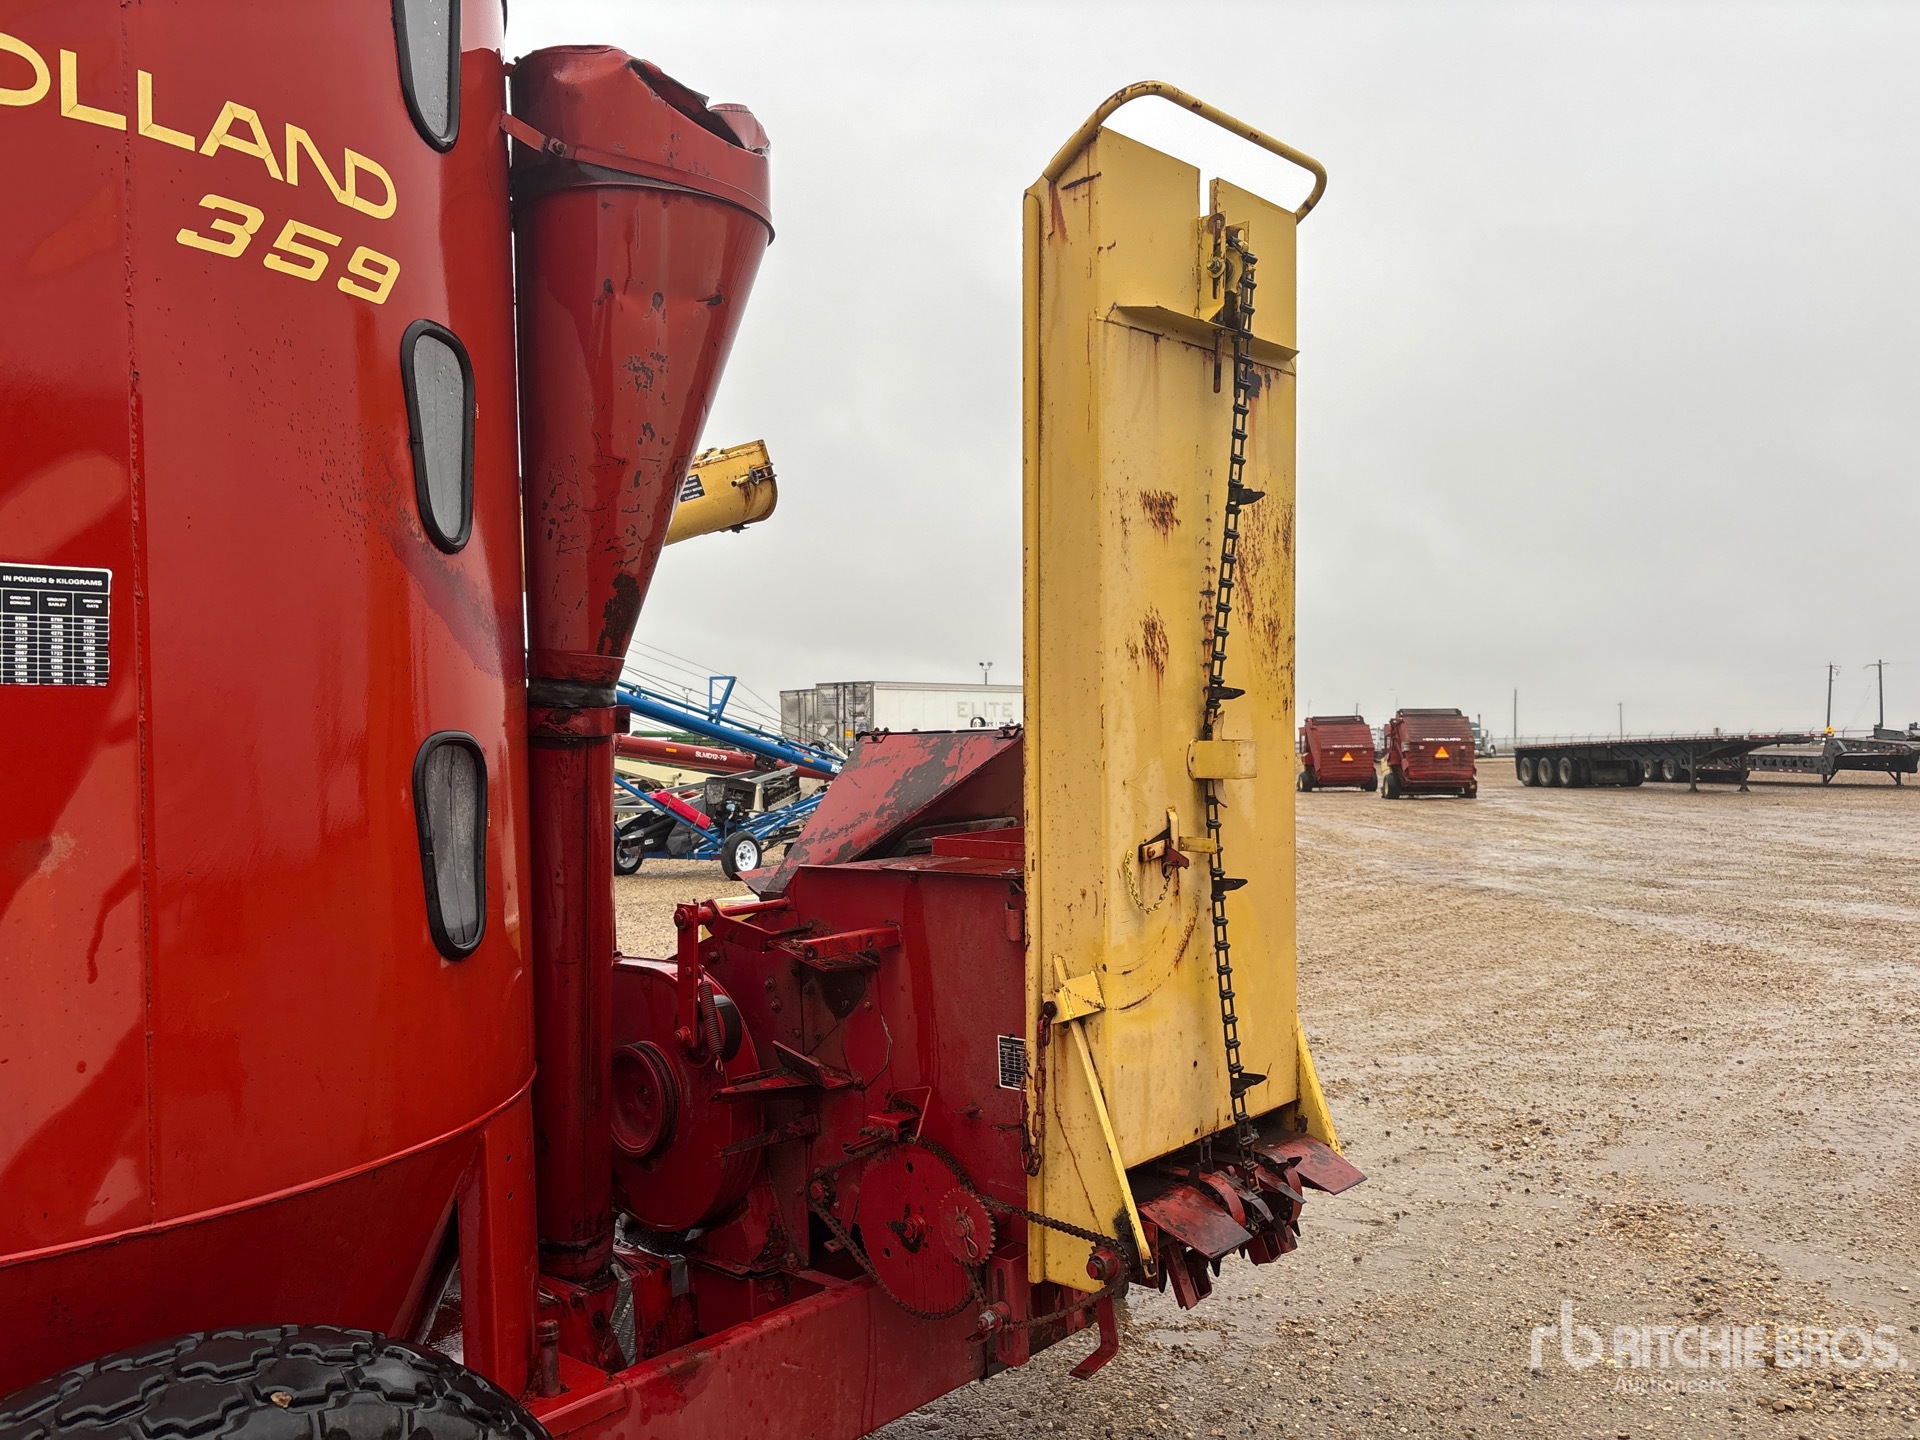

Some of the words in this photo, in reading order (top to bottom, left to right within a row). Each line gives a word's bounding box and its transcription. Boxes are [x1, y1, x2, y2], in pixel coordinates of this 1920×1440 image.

[176, 194, 400, 304] 359
[56, 578, 103, 586] KILOGRAMS
[957, 701, 1013, 718] ELITE
